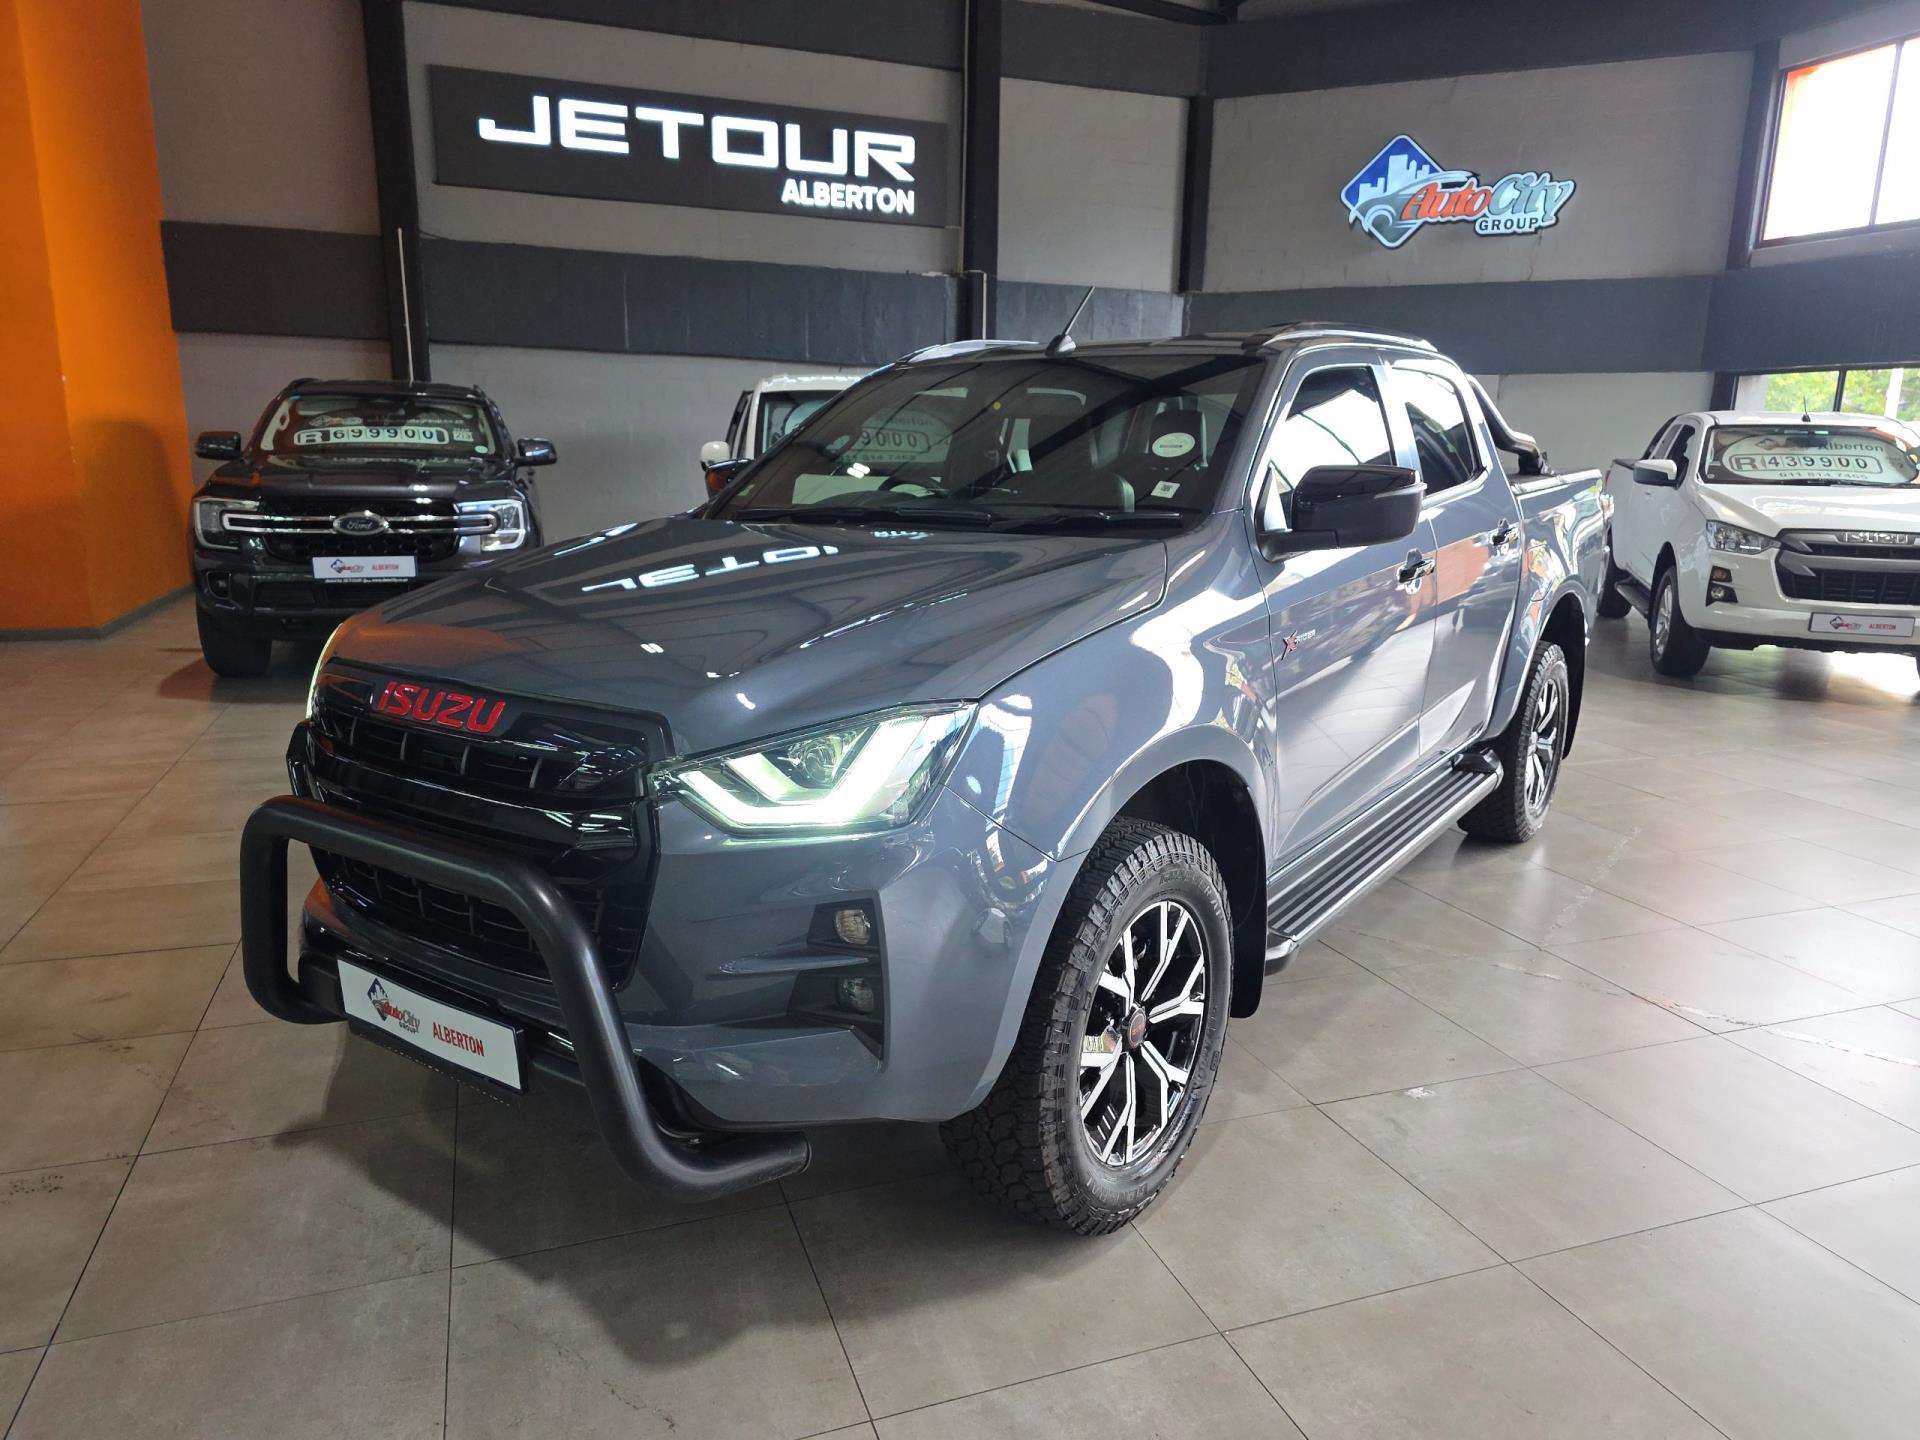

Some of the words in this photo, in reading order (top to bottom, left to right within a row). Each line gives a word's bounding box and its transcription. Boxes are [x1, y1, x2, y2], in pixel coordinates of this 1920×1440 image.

[478, 95, 916, 182] JETOUR
[781, 178, 915, 215] ALBERTON
[1401, 176, 1570, 221] AutoCity
[1479, 217, 1539, 231] GROUP
[333, 428, 435, 440] 699900
[1735, 456, 1760, 471] R
[1767, 455, 1868, 470] 439900
[377, 680, 506, 733] ISUZU
[432, 1022, 485, 1057] ALBERTON
